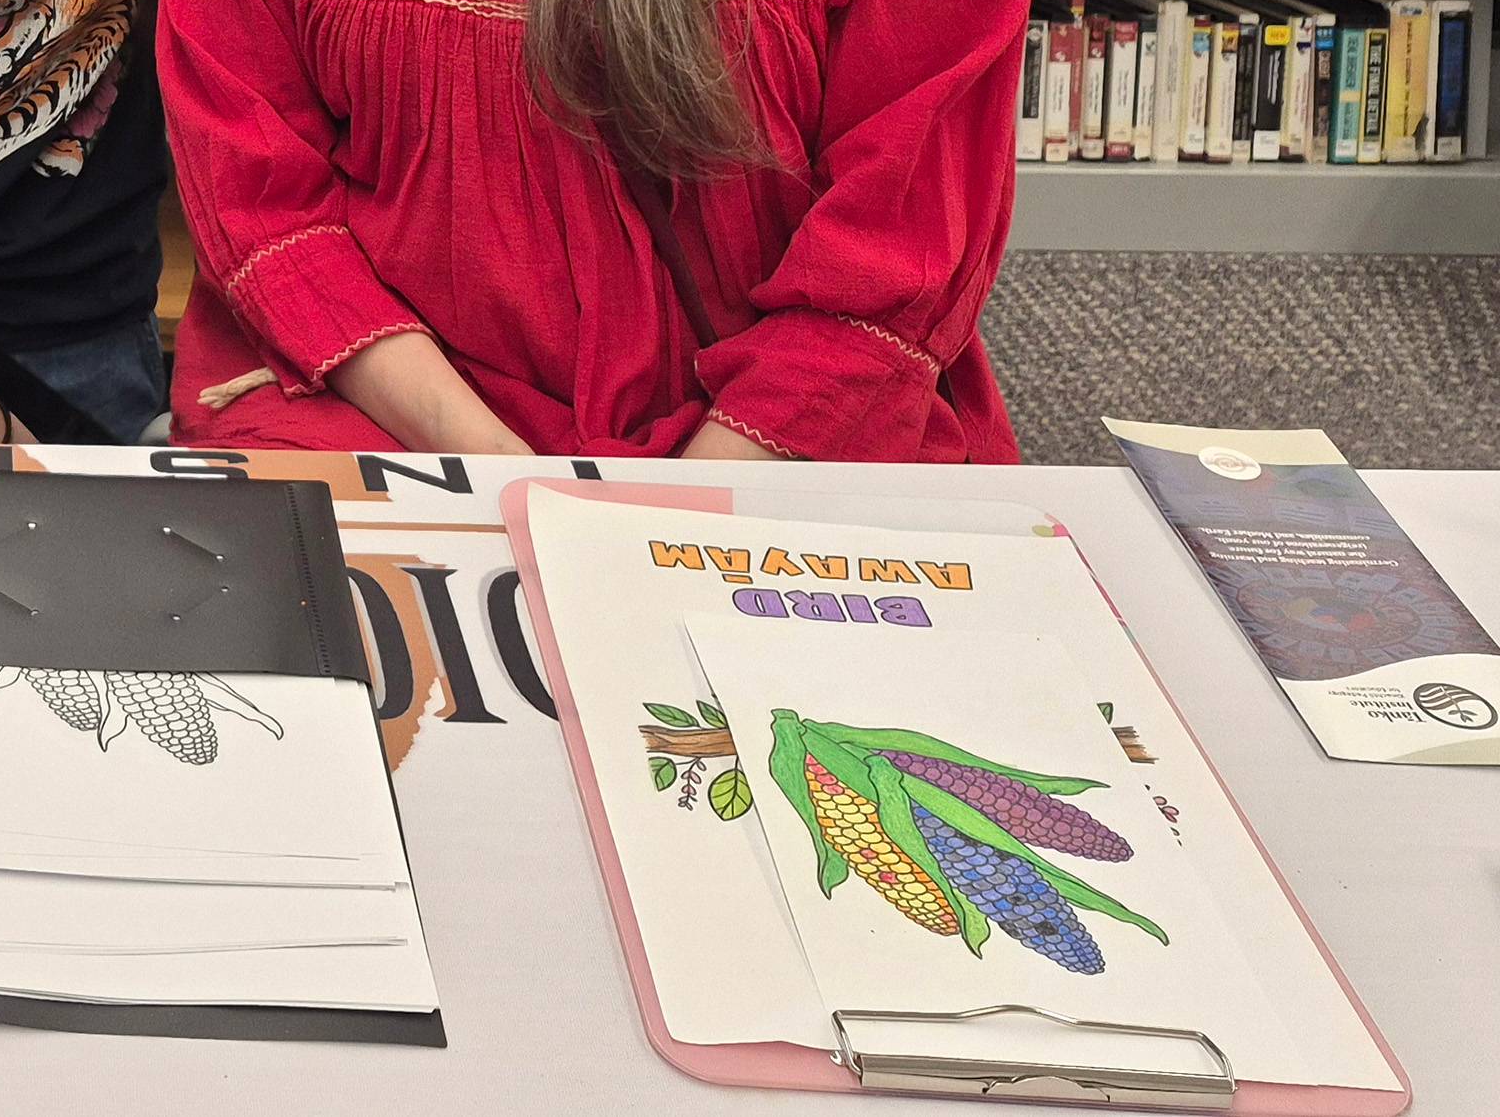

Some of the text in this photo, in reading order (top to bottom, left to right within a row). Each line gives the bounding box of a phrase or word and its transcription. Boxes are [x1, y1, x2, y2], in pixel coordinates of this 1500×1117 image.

[1274, 532, 1294, 540] and
[1283, 547, 1305, 555] way
[648, 540, 974, 591] AWAYĀM
[1208, 551, 1399, 567] Germinating teaching and learning
[732, 587, 932, 628] BIRD
[1350, 701, 1414, 711] Institute
